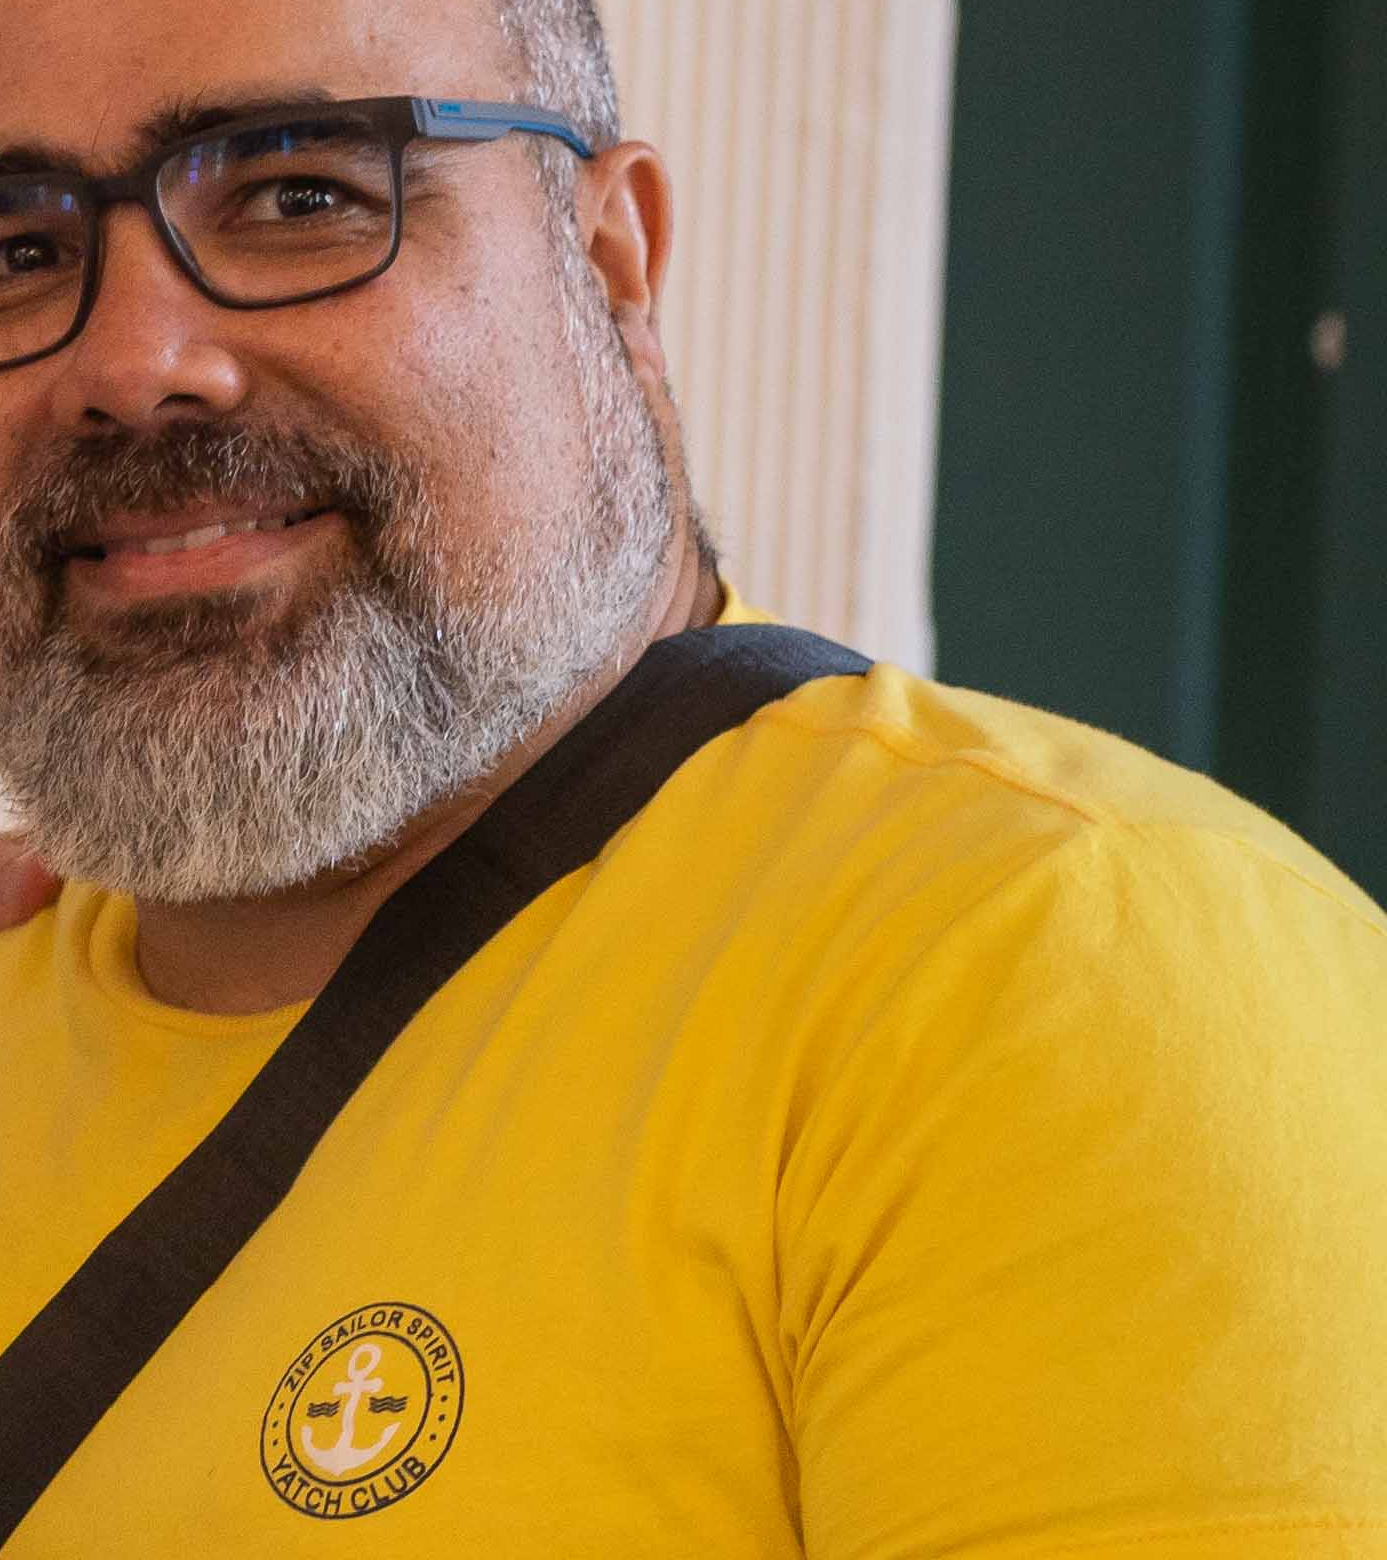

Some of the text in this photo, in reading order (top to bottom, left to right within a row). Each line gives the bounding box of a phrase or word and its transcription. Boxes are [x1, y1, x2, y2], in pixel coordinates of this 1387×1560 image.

[284, 1310, 455, 1392] ZIP SAILOR SPIRIT
[271, 1453, 428, 1515] YATCH CLUB
